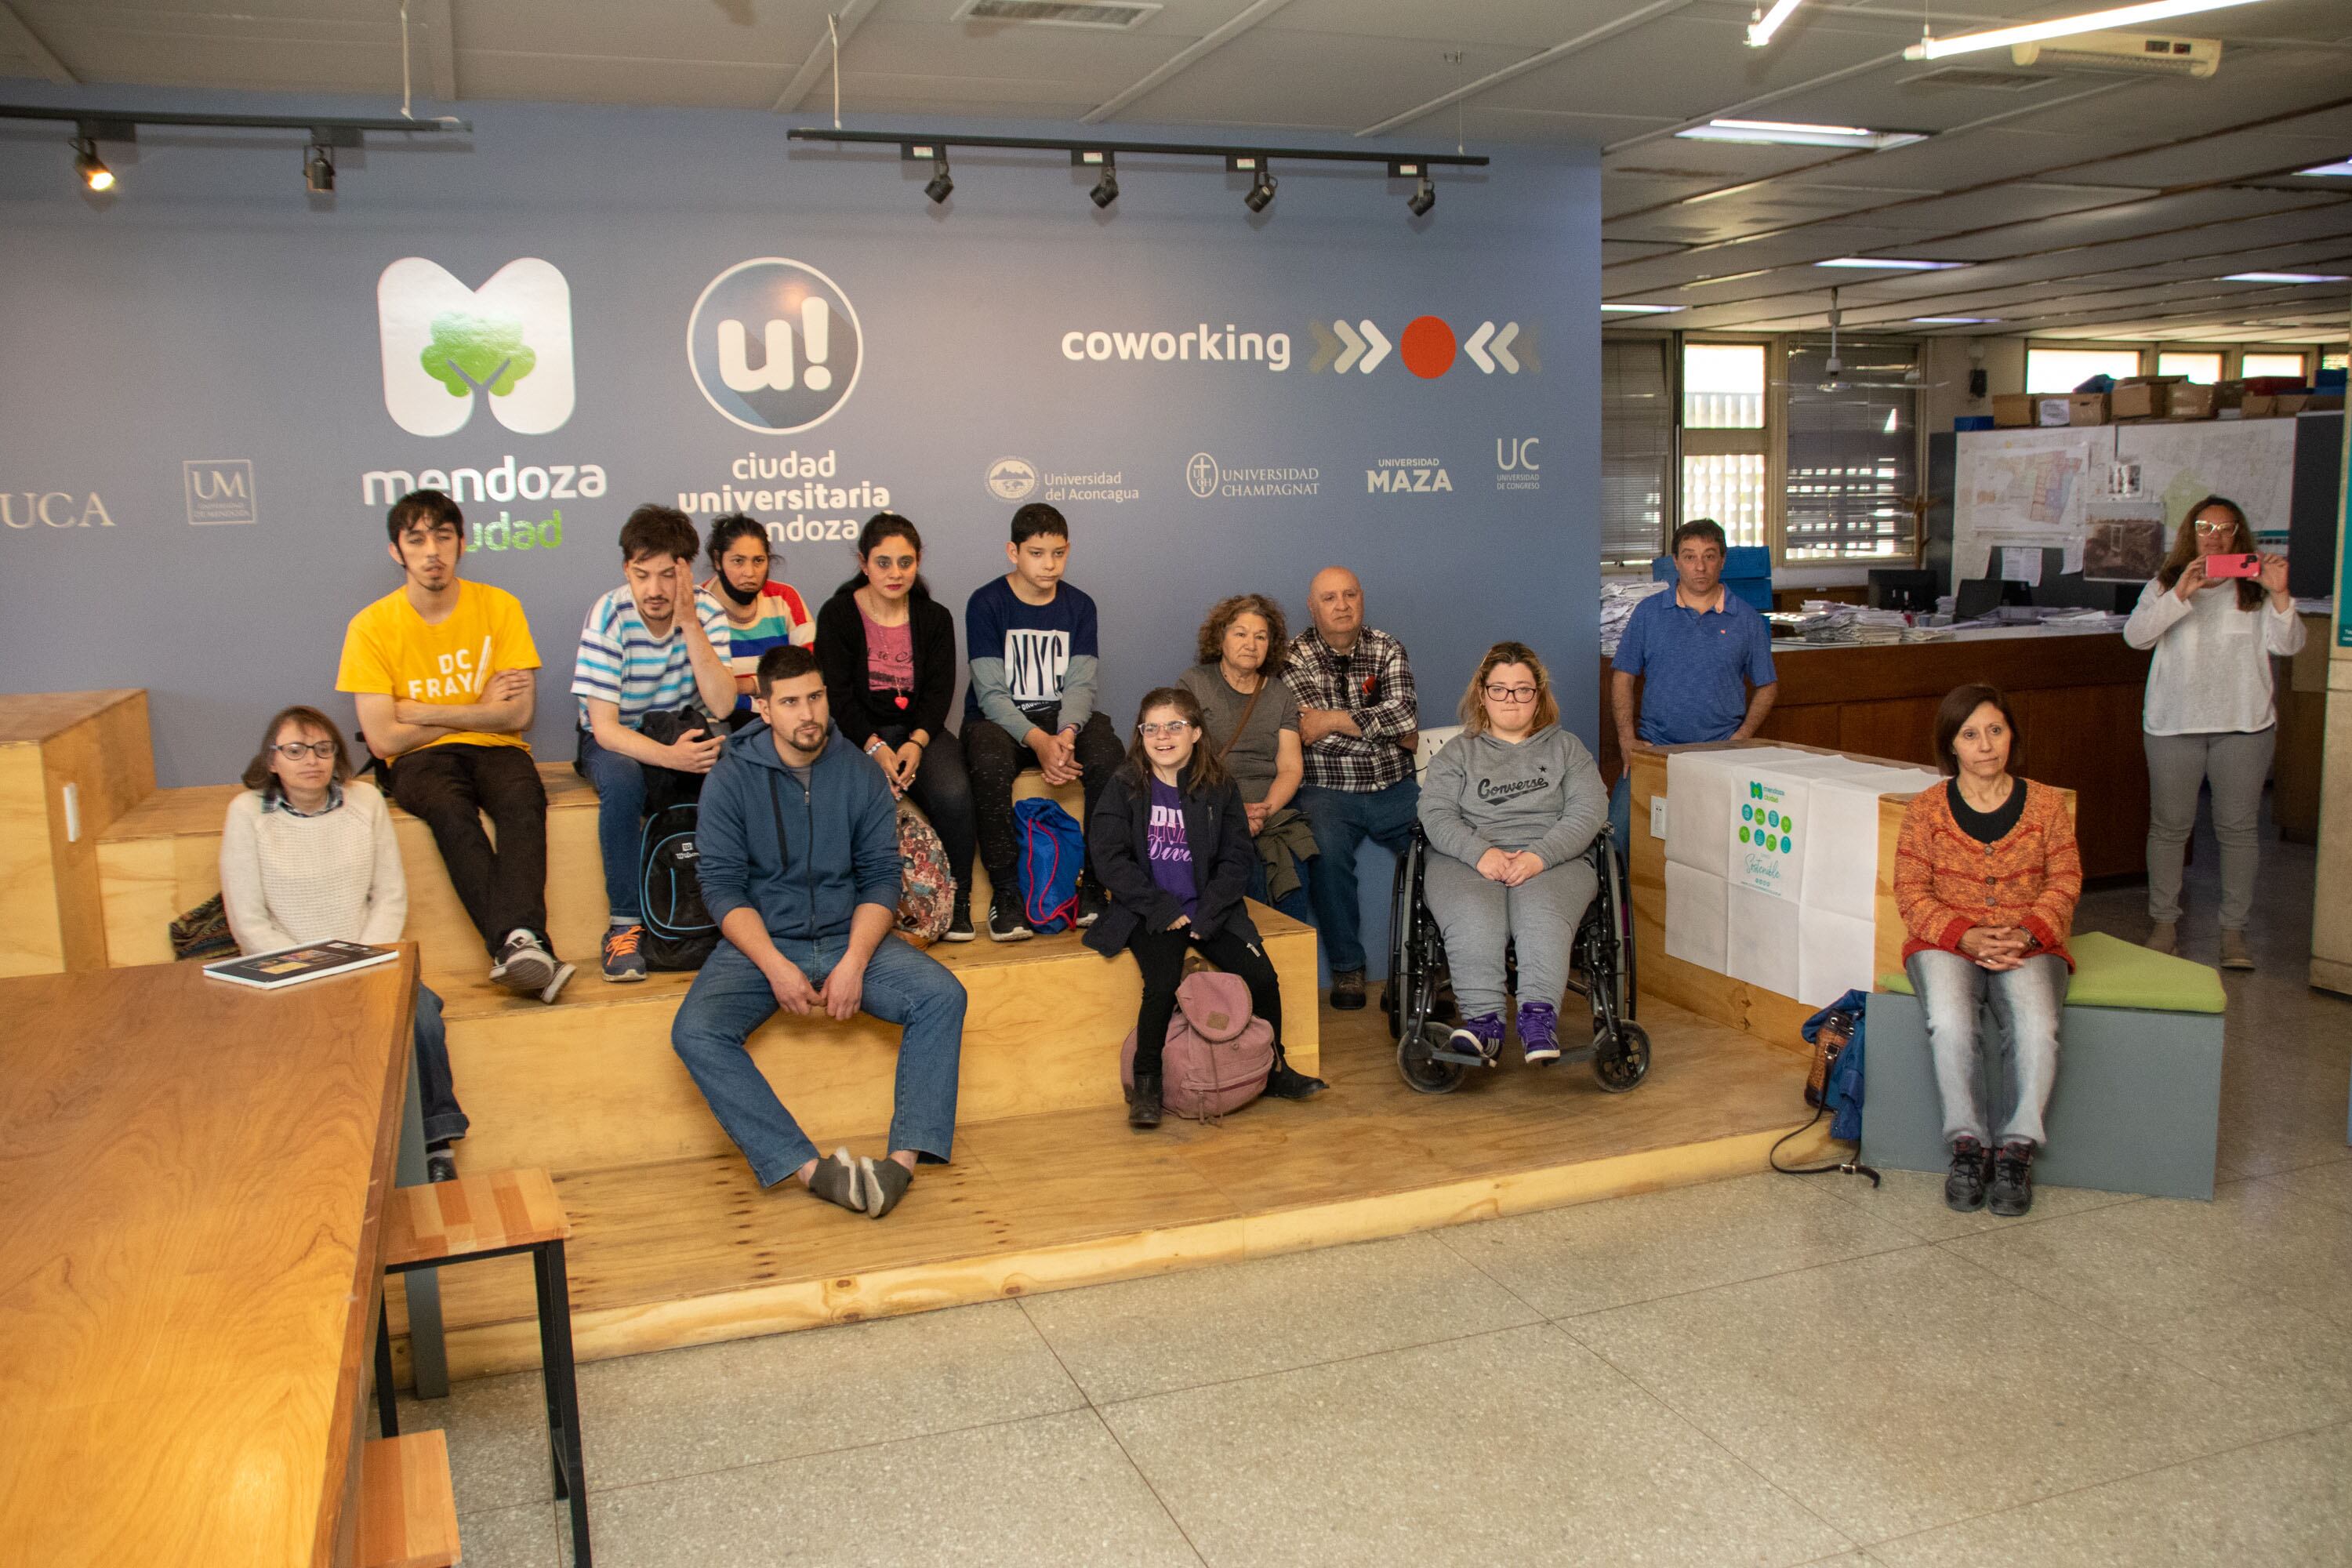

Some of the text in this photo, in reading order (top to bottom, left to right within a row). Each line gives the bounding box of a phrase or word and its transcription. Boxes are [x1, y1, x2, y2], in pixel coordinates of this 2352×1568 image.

[717, 296, 832, 393] u!
[1061, 323, 1290, 372] coworking
[732, 449, 837, 479] ciudad
[1378, 458, 1440, 467] UNIVERSIDAD
[1497, 437, 1540, 470] UC
[191, 470, 249, 499] UM
[361, 454, 608, 506] mendoza
[1044, 472, 1122, 486] Universidad
[1222, 468, 1319, 481] UNIVERSIDAD
[1365, 469, 1454, 493] MAZA
[1507, 481, 1540, 490] CONGRESO
[677, 481, 891, 514] universitaria
[1045, 487, 1140, 503] del Aconcagua
[1221, 483, 1320, 497] CHAMPAGNAT
[0, 492, 116, 528] UCA
[766, 514, 859, 543] ndoza
[437, 648, 473, 675] DC
[1009, 633, 1064, 697] NYC
[407, 671, 474, 700] FRAY
[1477, 778, 1546, 800] Converse
